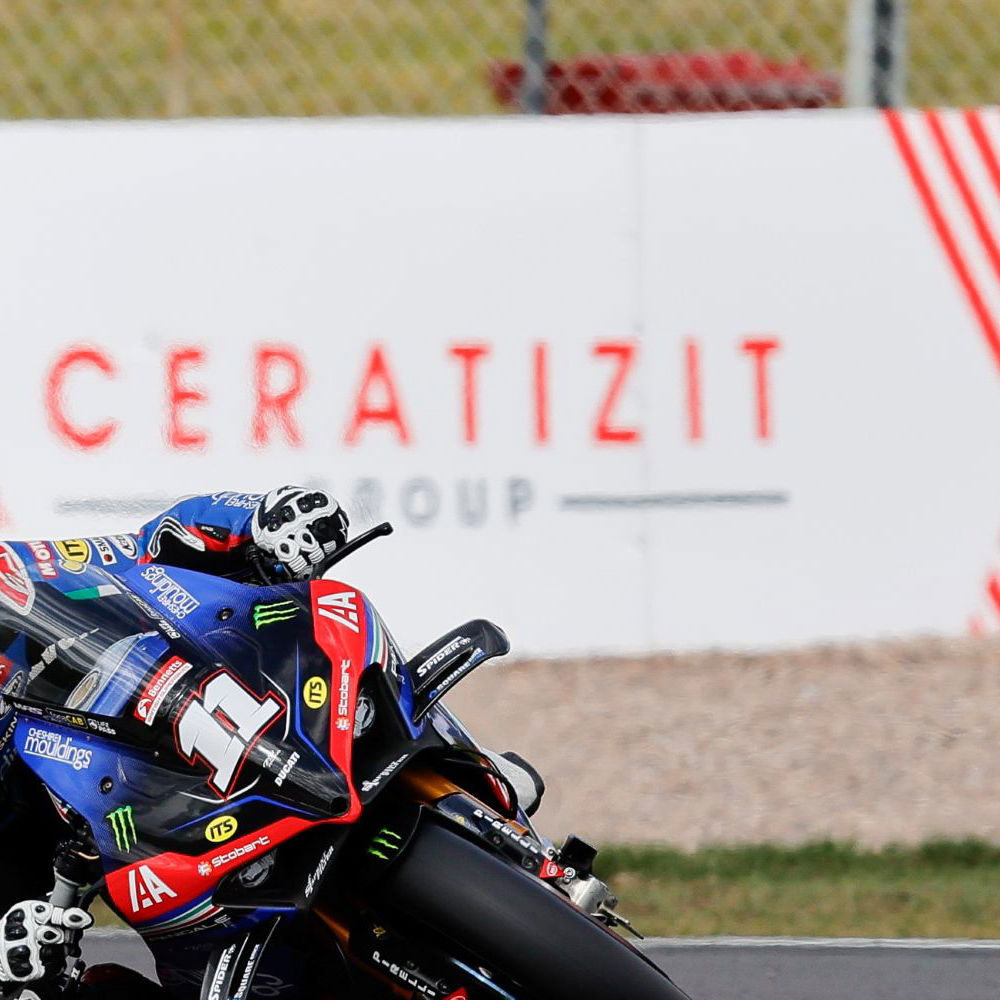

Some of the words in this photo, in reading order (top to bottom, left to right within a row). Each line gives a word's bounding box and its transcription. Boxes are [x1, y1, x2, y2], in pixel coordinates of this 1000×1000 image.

[44, 339, 783, 448] CERATIZIT
[306, 475, 534, 531] ROUP
[141, 566, 199, 614] mouldings
[417, 636, 463, 677] SPIDER
[148, 660, 183, 697] Bennetts
[309, 681, 322, 704] ITS
[338, 659, 351, 716] Stobart
[24, 736, 93, 771] mouldings
[274, 751, 301, 787] DUCATI
[209, 818, 233, 840] ITS
[473, 809, 539, 854] PIRELLI
[211, 836, 271, 868] Stobart
[372, 950, 436, 997] PIRELLI
